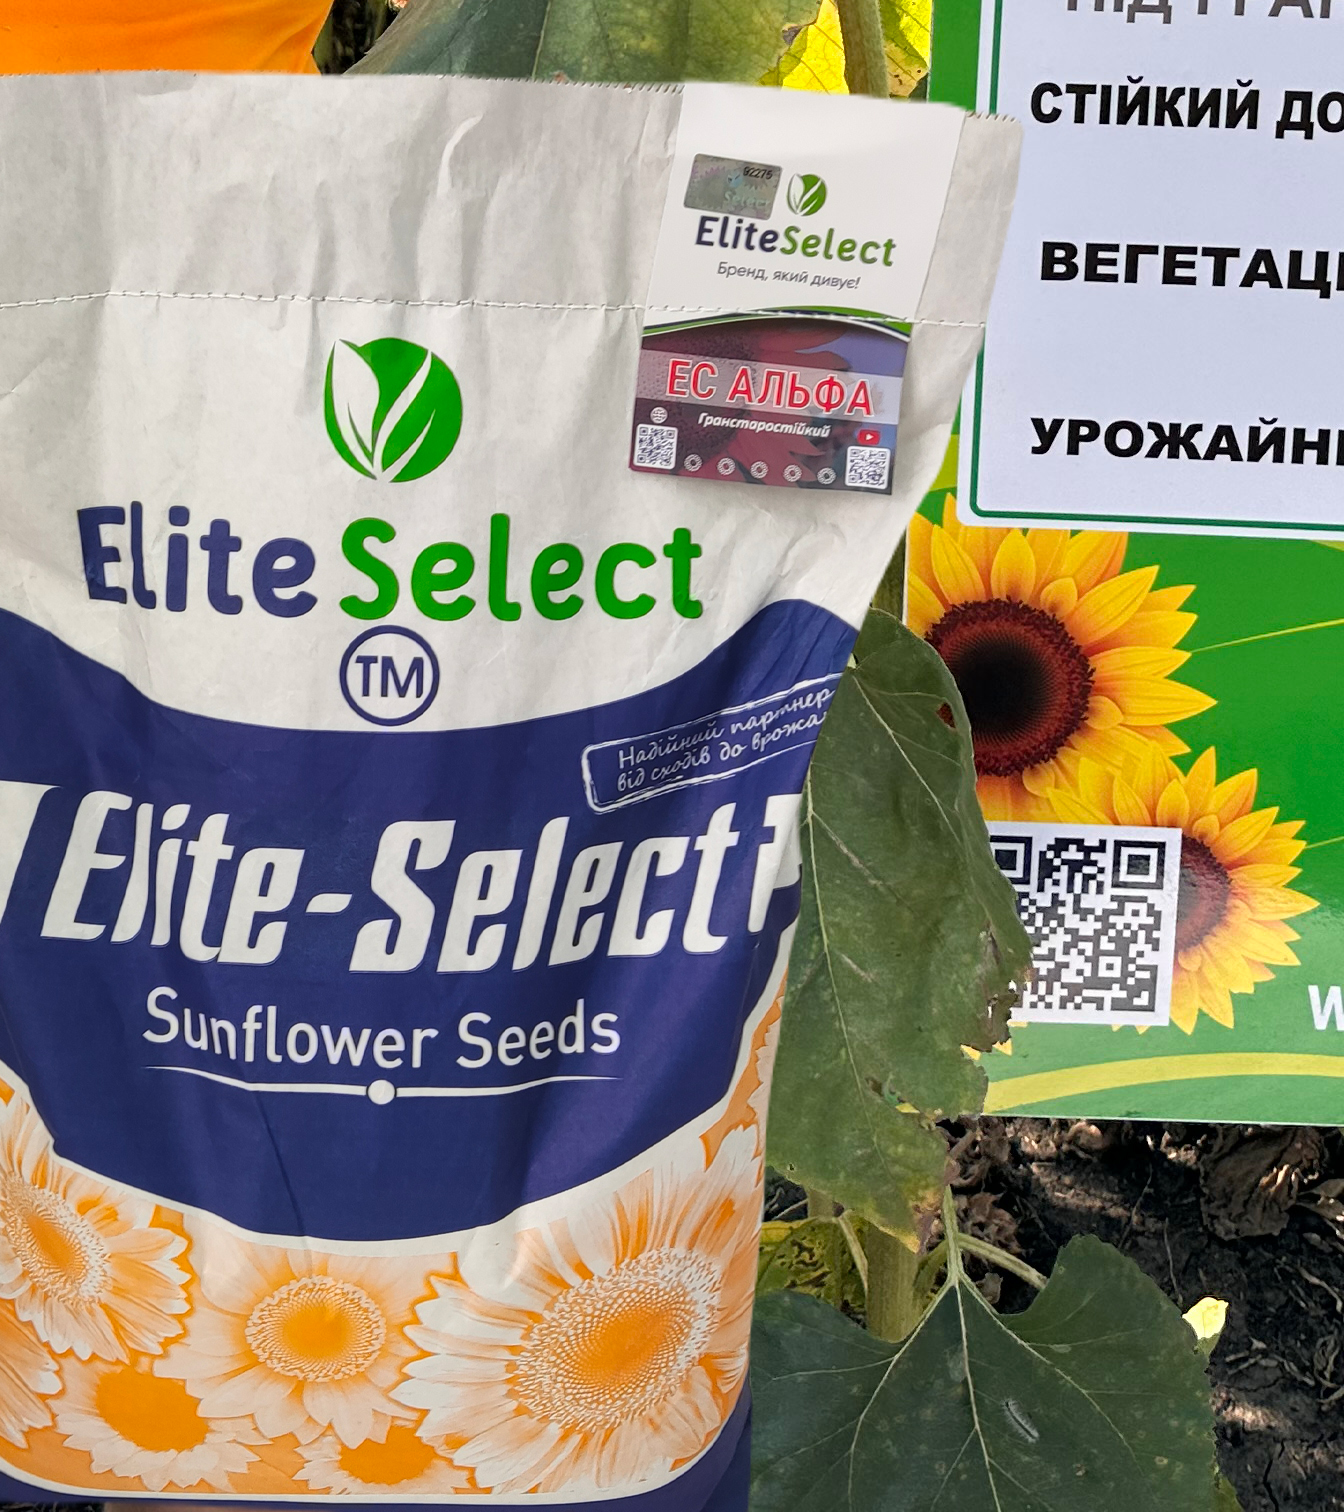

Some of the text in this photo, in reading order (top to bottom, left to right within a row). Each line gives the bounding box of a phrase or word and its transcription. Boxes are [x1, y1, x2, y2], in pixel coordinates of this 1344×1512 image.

[1031, 76, 1259, 129] СТІЙКИЙ
[717, 262, 861, 290] Бренд, який дивує!
[666, 358, 876, 418] ЕС АЛЬФА
[698, 411, 831, 439] Гранстаростійкий
[355, 655, 425, 699] TM
[618, 688, 836, 769] Надійний партнер
[617, 765, 646, 793] від
[651, 748, 711, 781] сходів
[719, 740, 748, 762] до
[40, 790, 740, 973] Elite-Select
[144, 986, 620, 1070] Sunflower Seeds
